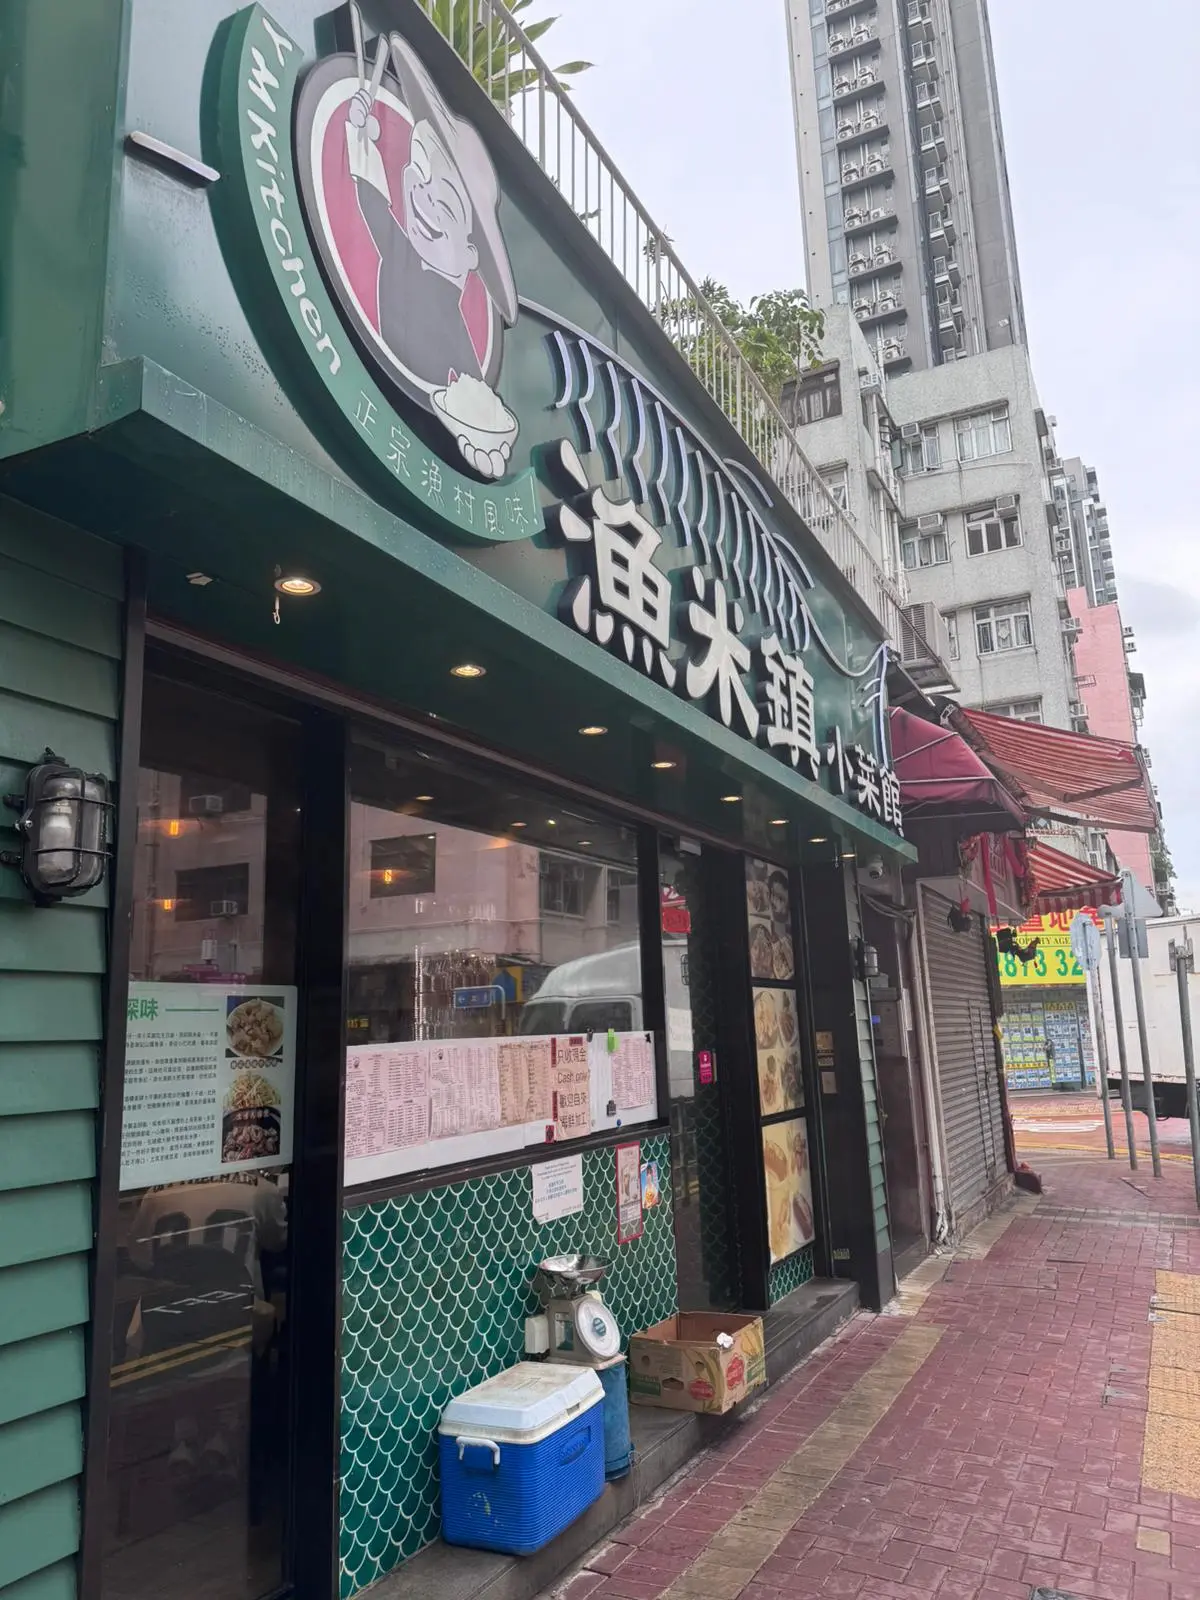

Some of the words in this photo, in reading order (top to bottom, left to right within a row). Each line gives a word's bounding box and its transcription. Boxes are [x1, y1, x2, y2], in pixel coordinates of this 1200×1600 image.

[560, 439, 820, 780] 漁米鎮
[827, 725, 904, 838] 小菜館
[557, 1072, 574, 1084] Cash
